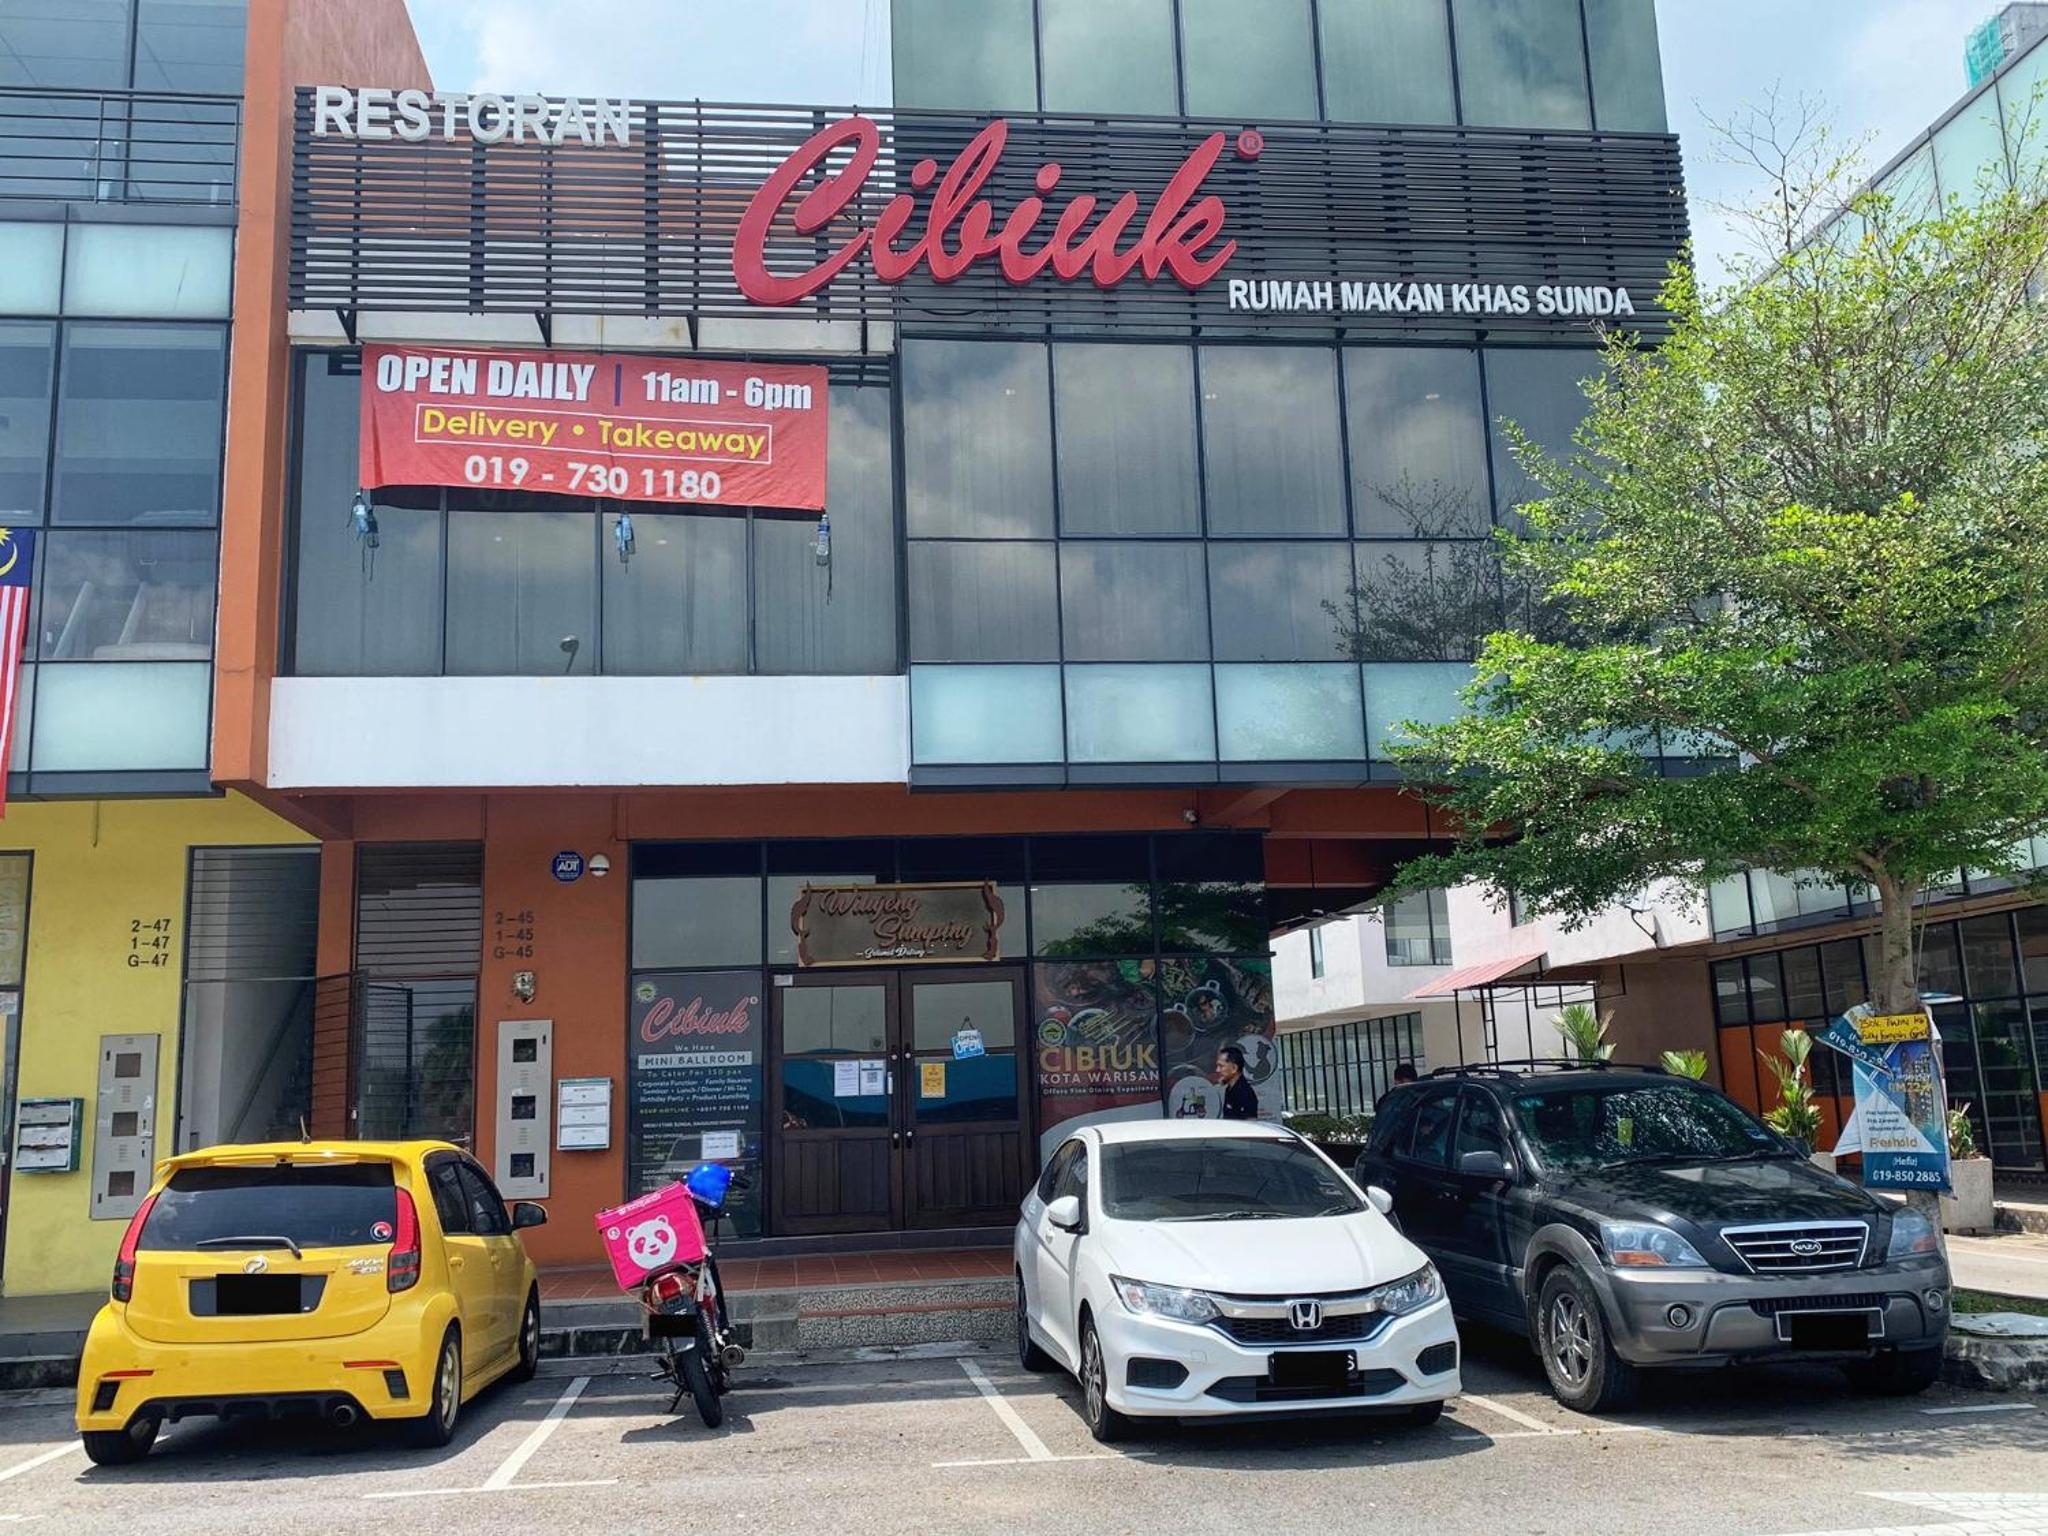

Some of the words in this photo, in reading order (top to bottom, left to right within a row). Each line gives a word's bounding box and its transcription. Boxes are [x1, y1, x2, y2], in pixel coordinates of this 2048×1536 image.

[314, 86, 630, 147] RESTORAN
[733, 116, 1237, 306] Cibiuk
[1229, 279, 1333, 312] RUMAH
[1341, 282, 1445, 314] MAKAN
[1452, 284, 1530, 315] KHAS
[1536, 285, 1635, 316] SUNDA
[376, 353, 478, 397] OPEN
[487, 359, 597, 402] DAILY
[642, 370, 720, 404] 11am
[744, 377, 812, 411] 6pm
[423, 409, 557, 445] Delivery
[599, 420, 766, 459] Takeaway
[465, 456, 526, 486] 019
[567, 463, 628, 496] 730
[640, 468, 721, 500] 1180
[557, 859, 580, 872] ADT
[131, 918, 172, 932] 2-47
[131, 935, 170, 949] 1-47
[127, 953, 169, 968] G-47
[641, 996, 750, 1043] Cibiuk
[645, 1057, 673, 1066] MINI
[679, 1054, 745, 1065] BALLROOM
[1040, 1044, 1159, 1073] CIBIUK
[1040, 1073, 1081, 1086] KOTA
[1088, 1070, 1160, 1083] WARISAN
[1872, 1170, 1915, 1181] 019-850
[1793, 1242, 1821, 1252] NAZA
